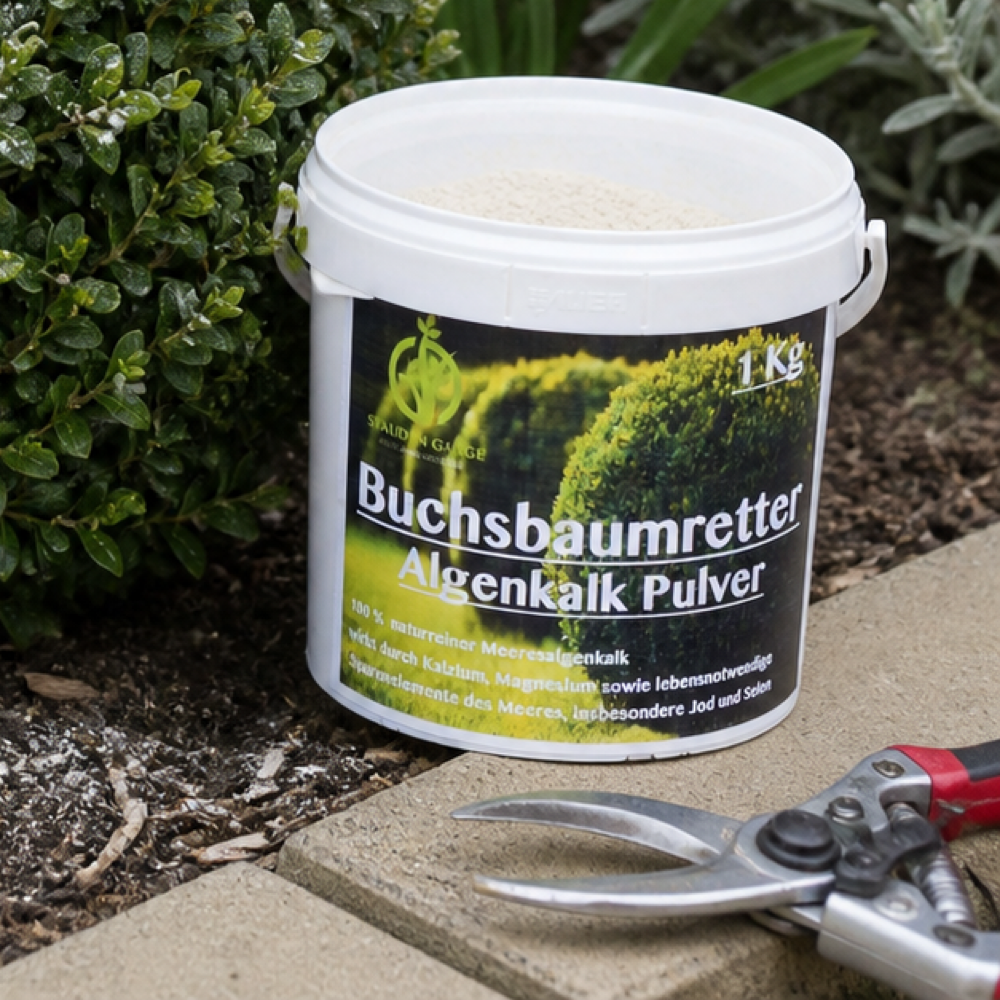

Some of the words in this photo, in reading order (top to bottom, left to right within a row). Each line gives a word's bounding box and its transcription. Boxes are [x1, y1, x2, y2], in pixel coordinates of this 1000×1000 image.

[738, 355, 751, 386] 1
[765, 340, 805, 381] Kg
[357, 461, 804, 558] Buchsbaumretter
[399, 546, 629, 612] Algenkalk
[645, 562, 766, 612] Pulver
[373, 608, 385, 625] %
[390, 618, 477, 652] naturreiner
[380, 640, 418, 666] durch
[495, 672, 597, 695] Magnesium
[602, 677, 651, 693] sowie
[655, 651, 773, 692] lebensnotwendige
[463, 692, 492, 711] des
[498, 699, 568, 722] Meeres,
[689, 694, 715, 714] Jod
[718, 688, 741, 707] und
[743, 678, 772, 700] Selen
